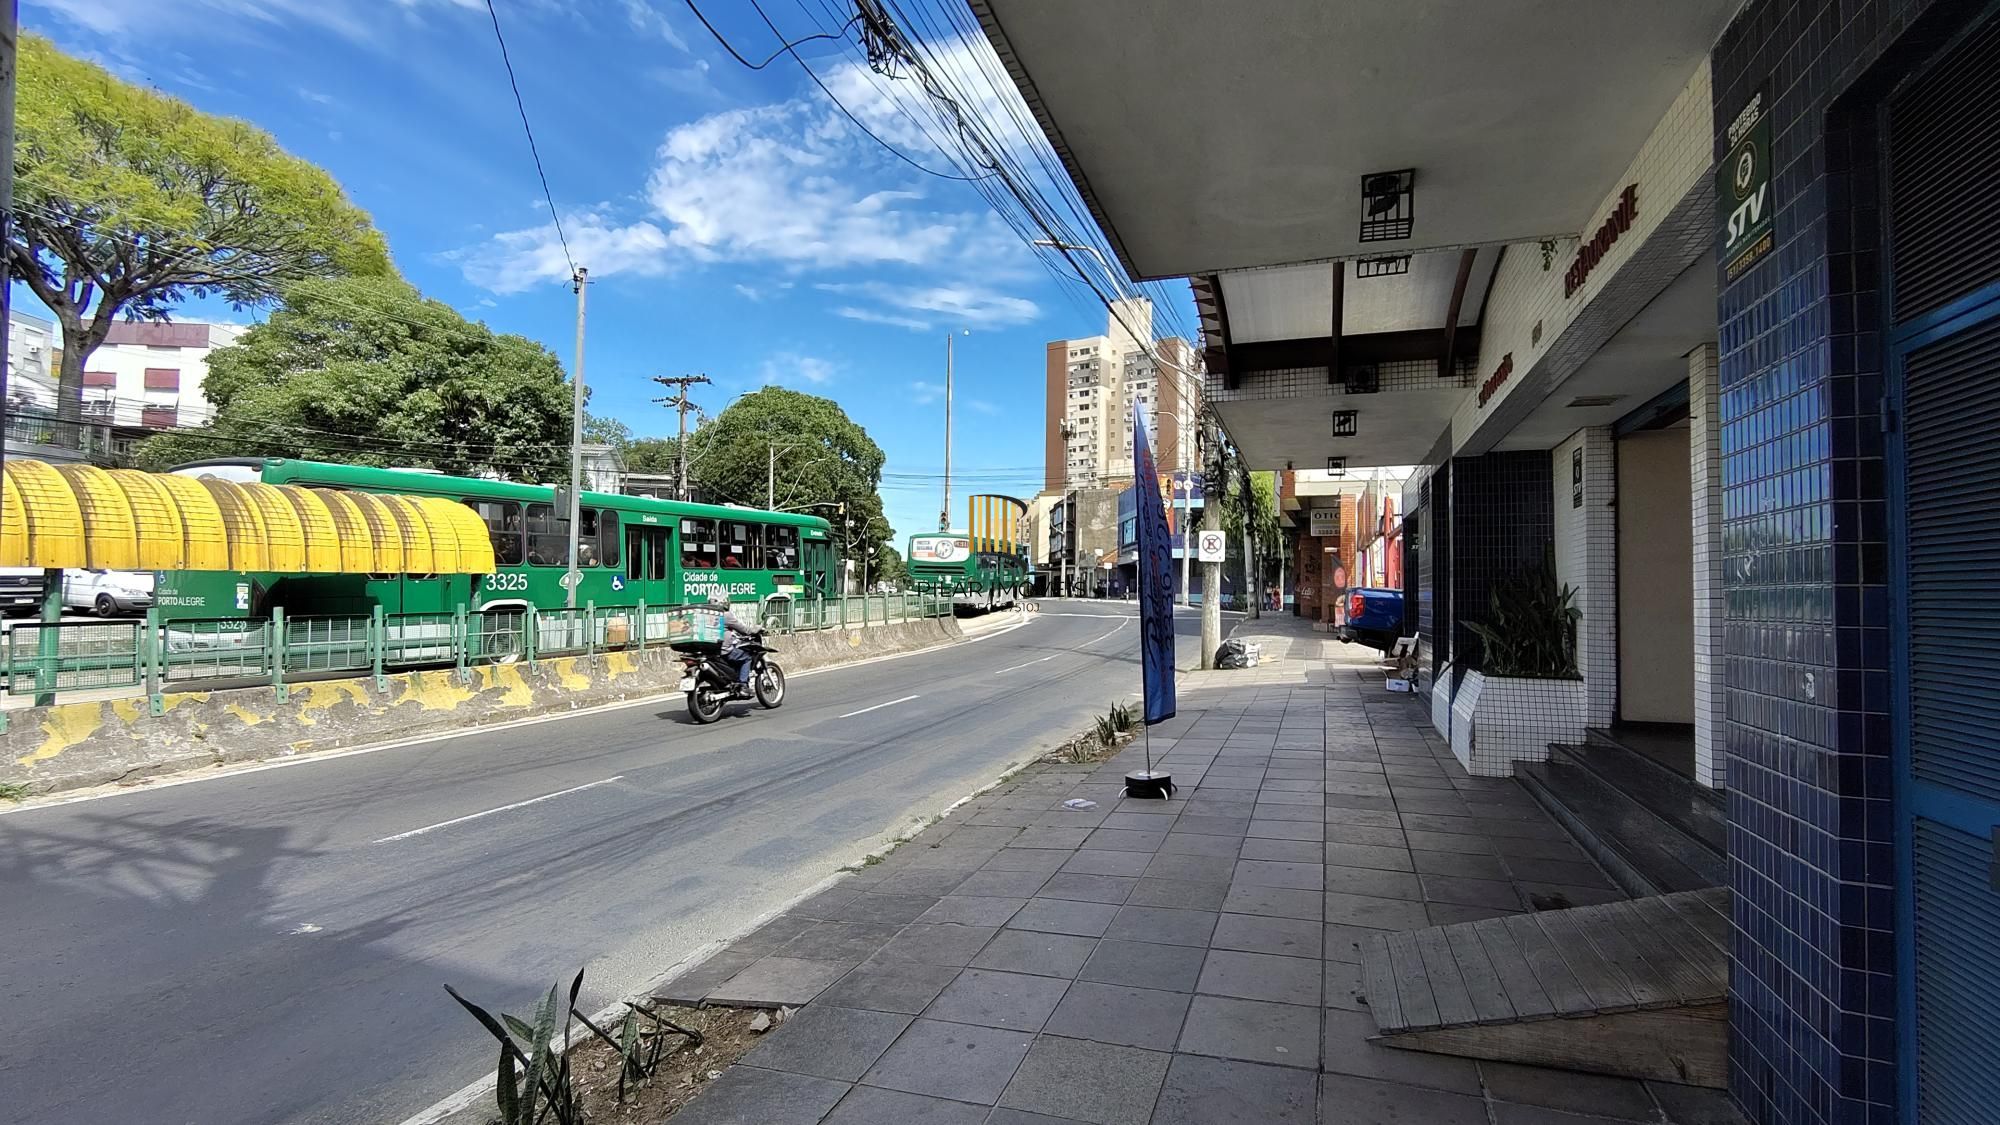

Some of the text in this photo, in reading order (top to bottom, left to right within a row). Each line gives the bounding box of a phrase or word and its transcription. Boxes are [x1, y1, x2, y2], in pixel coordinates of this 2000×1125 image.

[1728, 92, 1762, 139] PROTEGIDO
[1738, 108, 1760, 142] HORAS
[1725, 181, 1768, 248] STV
[486, 573, 528, 591] 3325
[683, 572, 718, 582] Cidade de
[158, 597, 205, 606] PORTO ALEGRE
